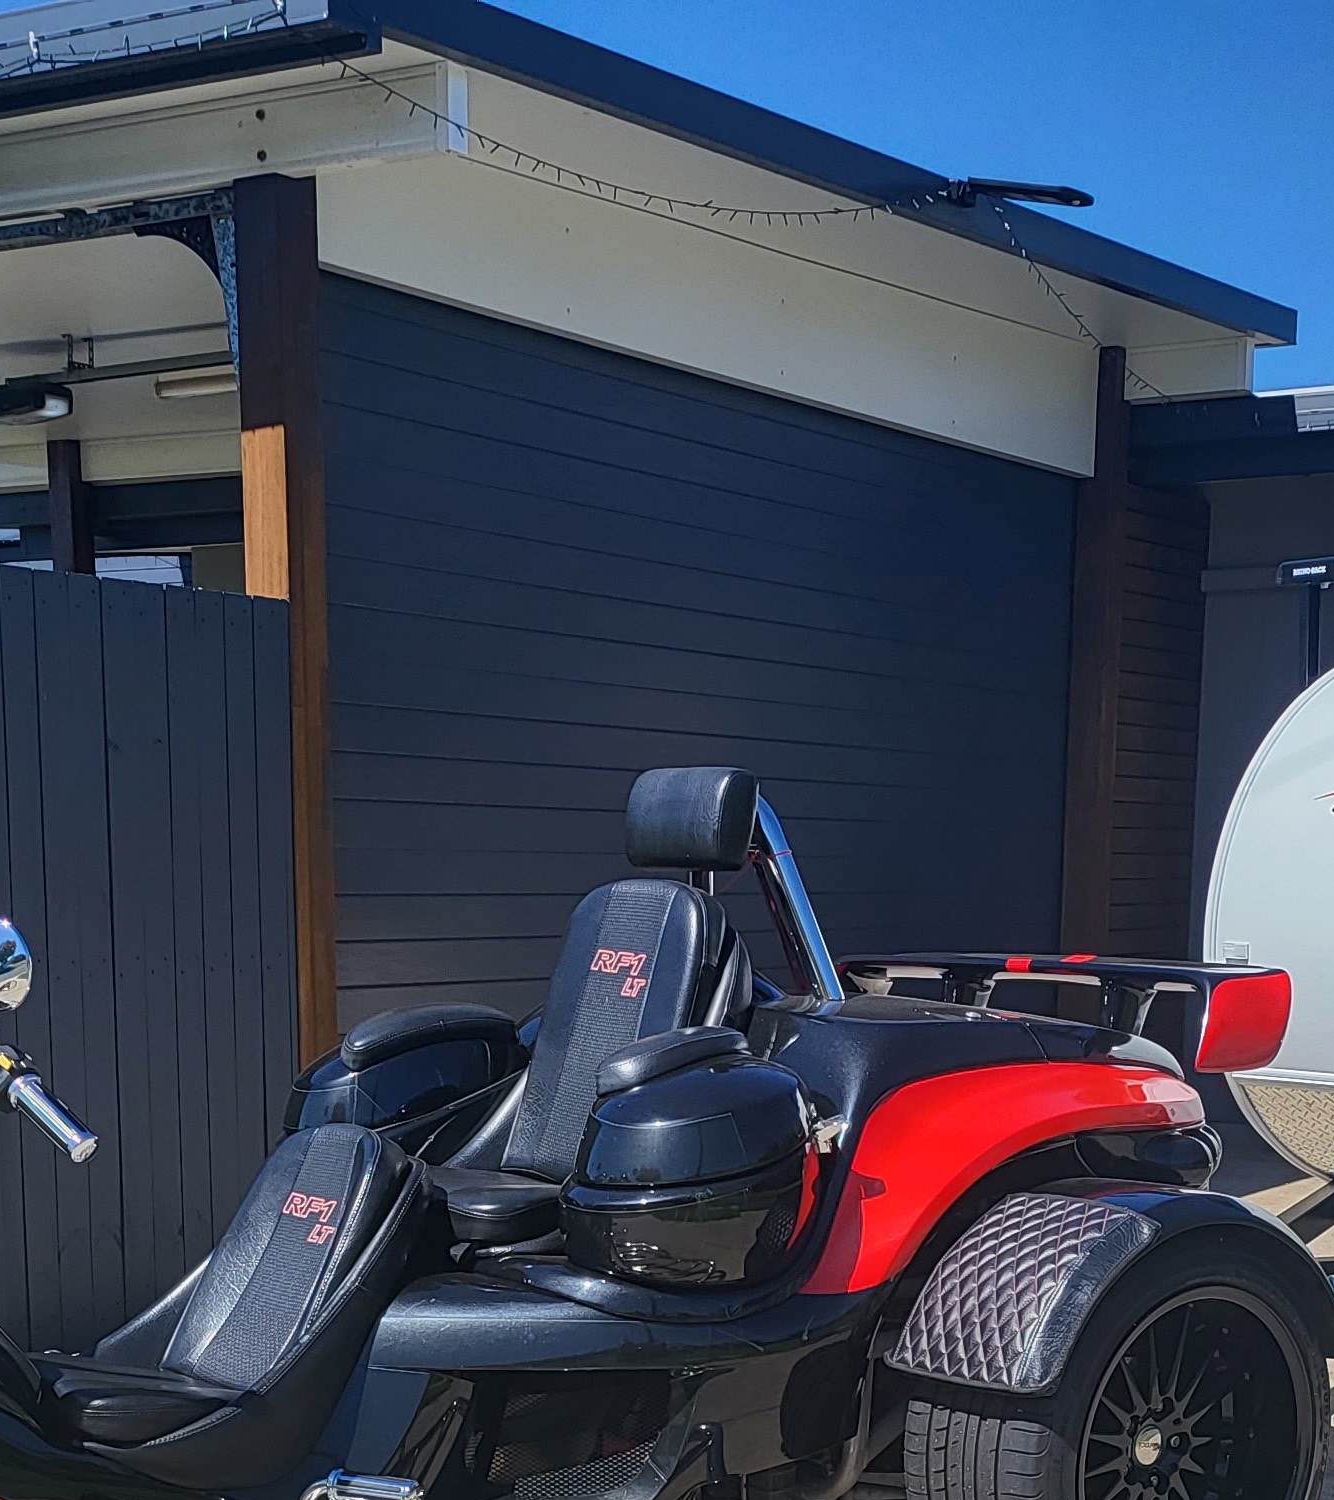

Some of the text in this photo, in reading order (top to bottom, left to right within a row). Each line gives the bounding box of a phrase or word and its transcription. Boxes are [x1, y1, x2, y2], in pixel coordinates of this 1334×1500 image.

[589, 948, 647, 977] RF1
[620, 976, 647, 998] LT
[282, 1191, 337, 1223] RF1
[306, 1223, 337, 1245] LT
